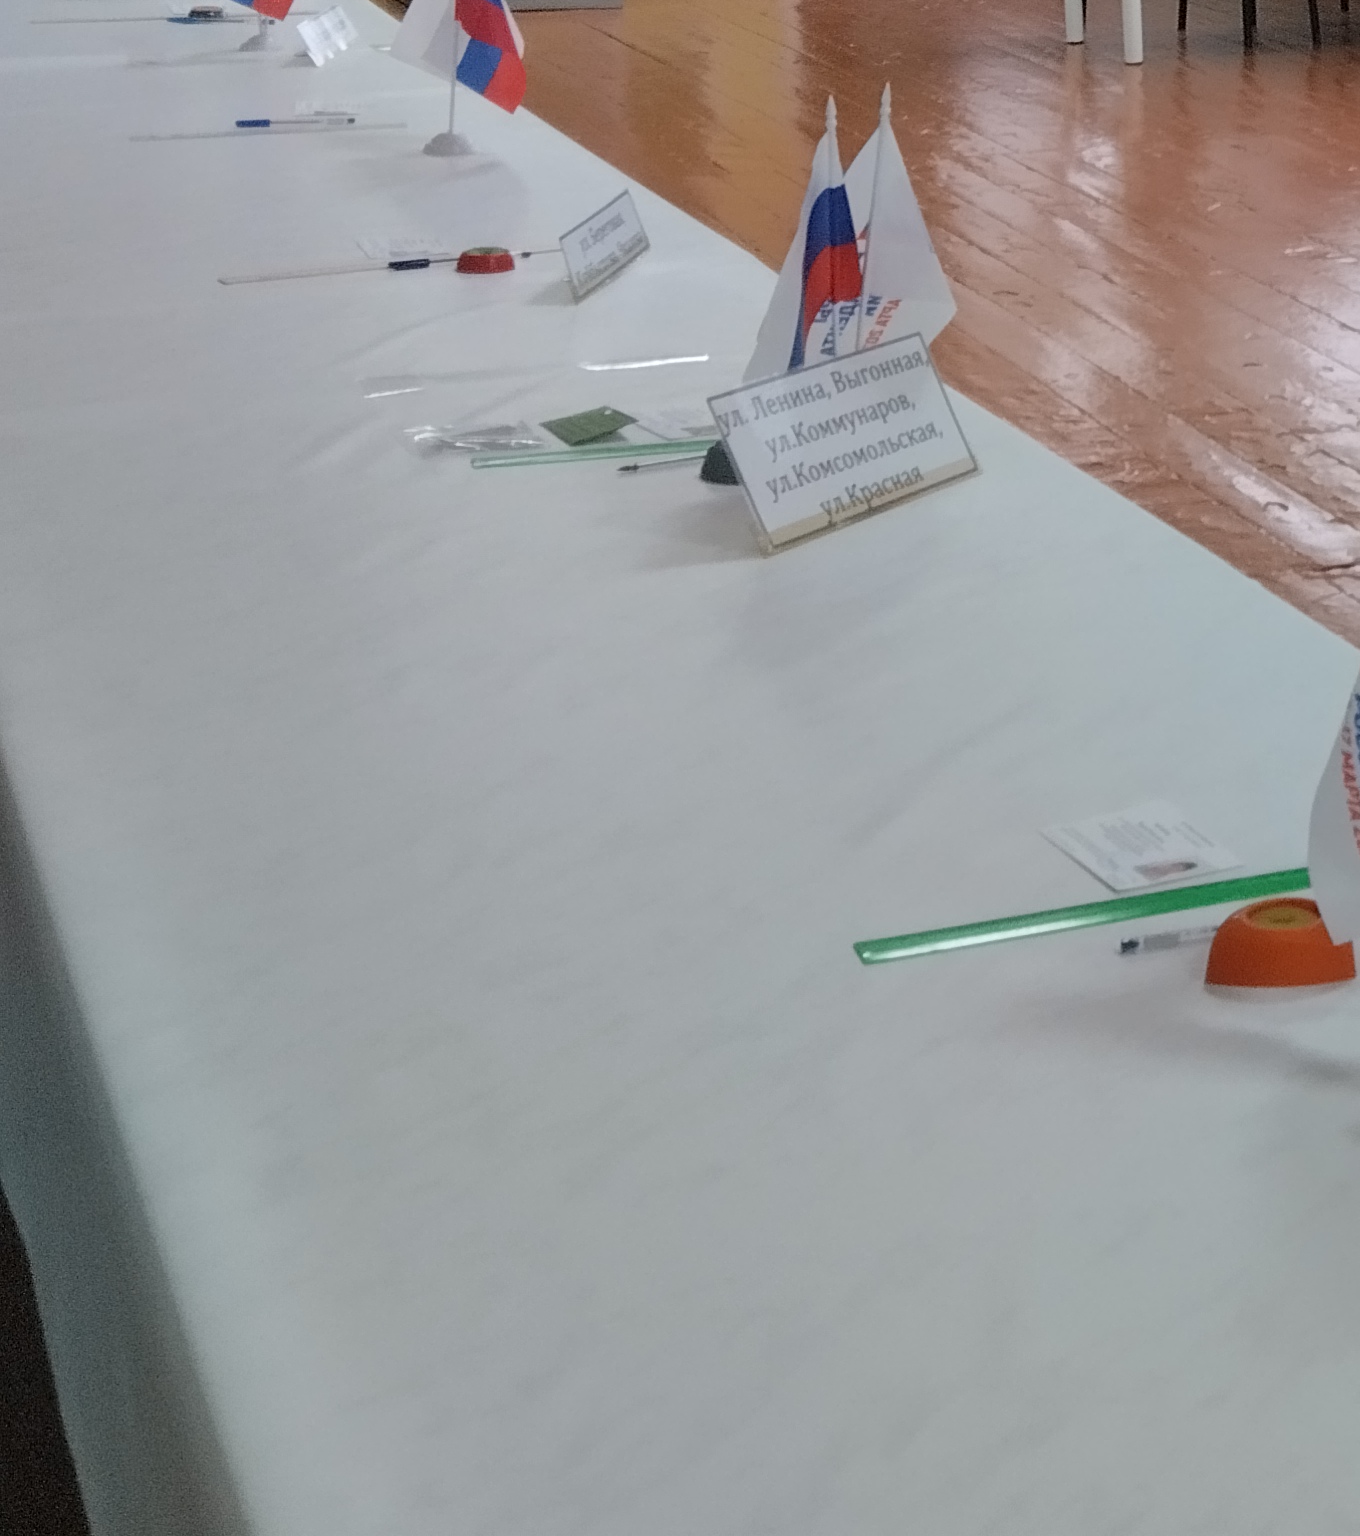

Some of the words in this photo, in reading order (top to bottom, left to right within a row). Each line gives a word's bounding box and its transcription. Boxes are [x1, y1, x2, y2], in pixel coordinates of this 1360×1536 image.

[716, 407, 749, 438] ул.
[751, 381, 832, 420] Ленина,
[829, 349, 931, 395] Выгонная,
[764, 392, 916, 463] ул.Коммунаров,
[765, 421, 944, 503] ул.Комсомольская,
[819, 465, 925, 525] ул.Красная
